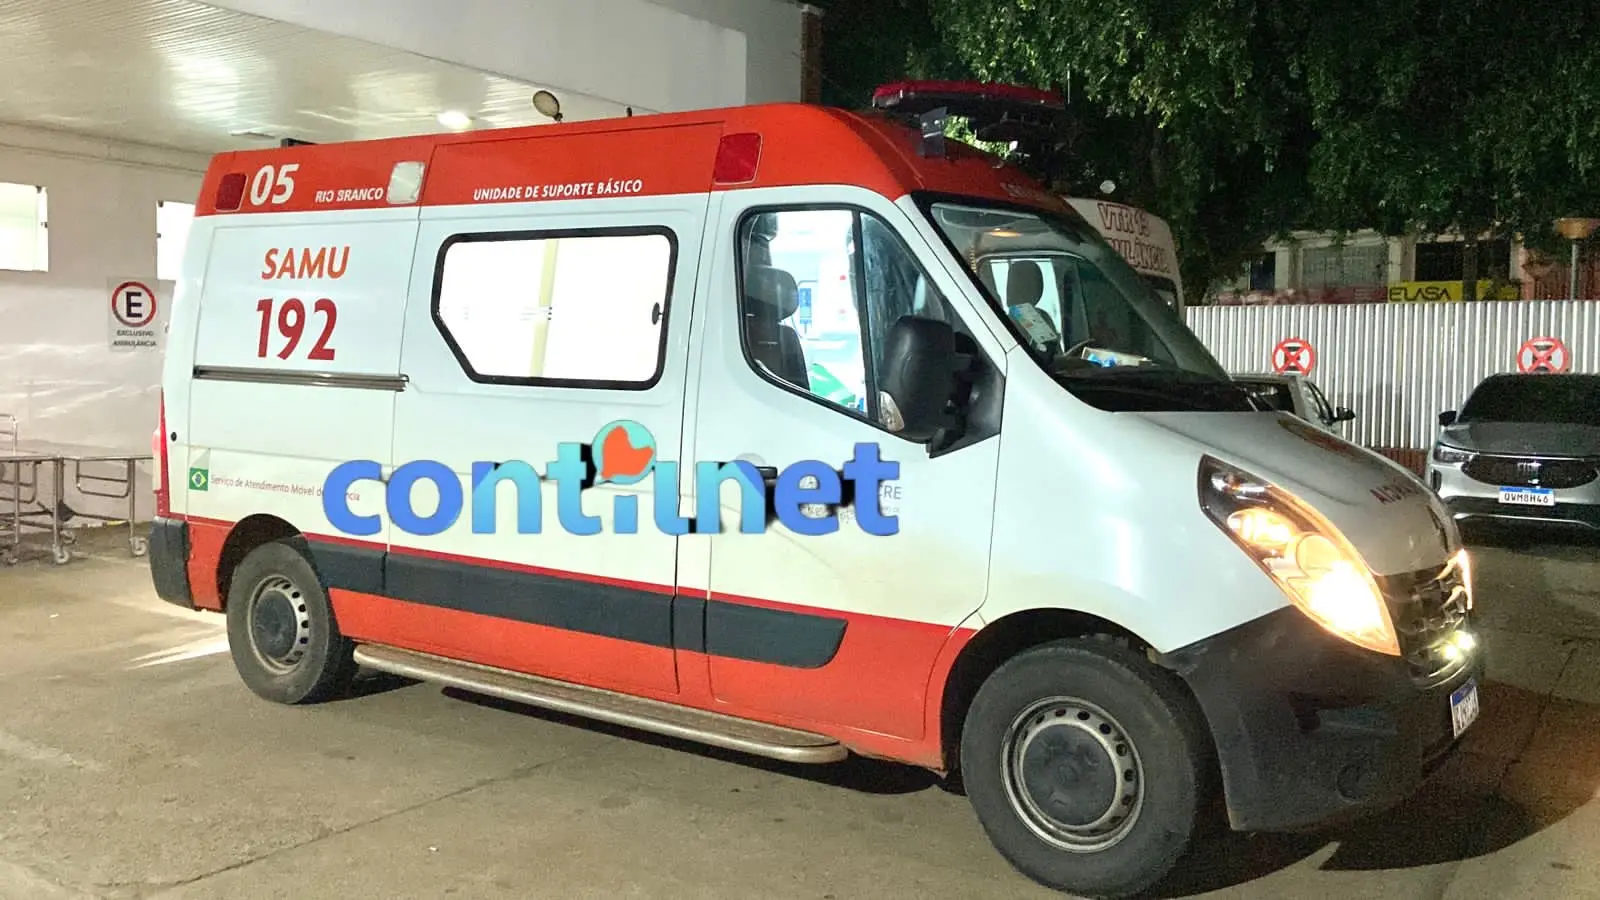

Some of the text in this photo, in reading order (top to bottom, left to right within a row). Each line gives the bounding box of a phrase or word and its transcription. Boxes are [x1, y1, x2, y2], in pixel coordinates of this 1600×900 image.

[250, 164, 299, 206] 05
[315, 187, 384, 203] RIO BRANCO
[473, 178, 643, 201] UNIDADE DE SUPORTE BÁSICO
[1097, 203, 1134, 233] VTR
[261, 246, 350, 280] SAMU
[126, 292, 142, 317] E
[116, 329, 154, 337] EXCLUSIVO
[256, 298, 337, 361] 192
[211, 475, 233, 487] Serviço
[235, 477, 243, 487] de
[244, 480, 289, 493] Atendimento
[291, 484, 315, 497] Móvel
